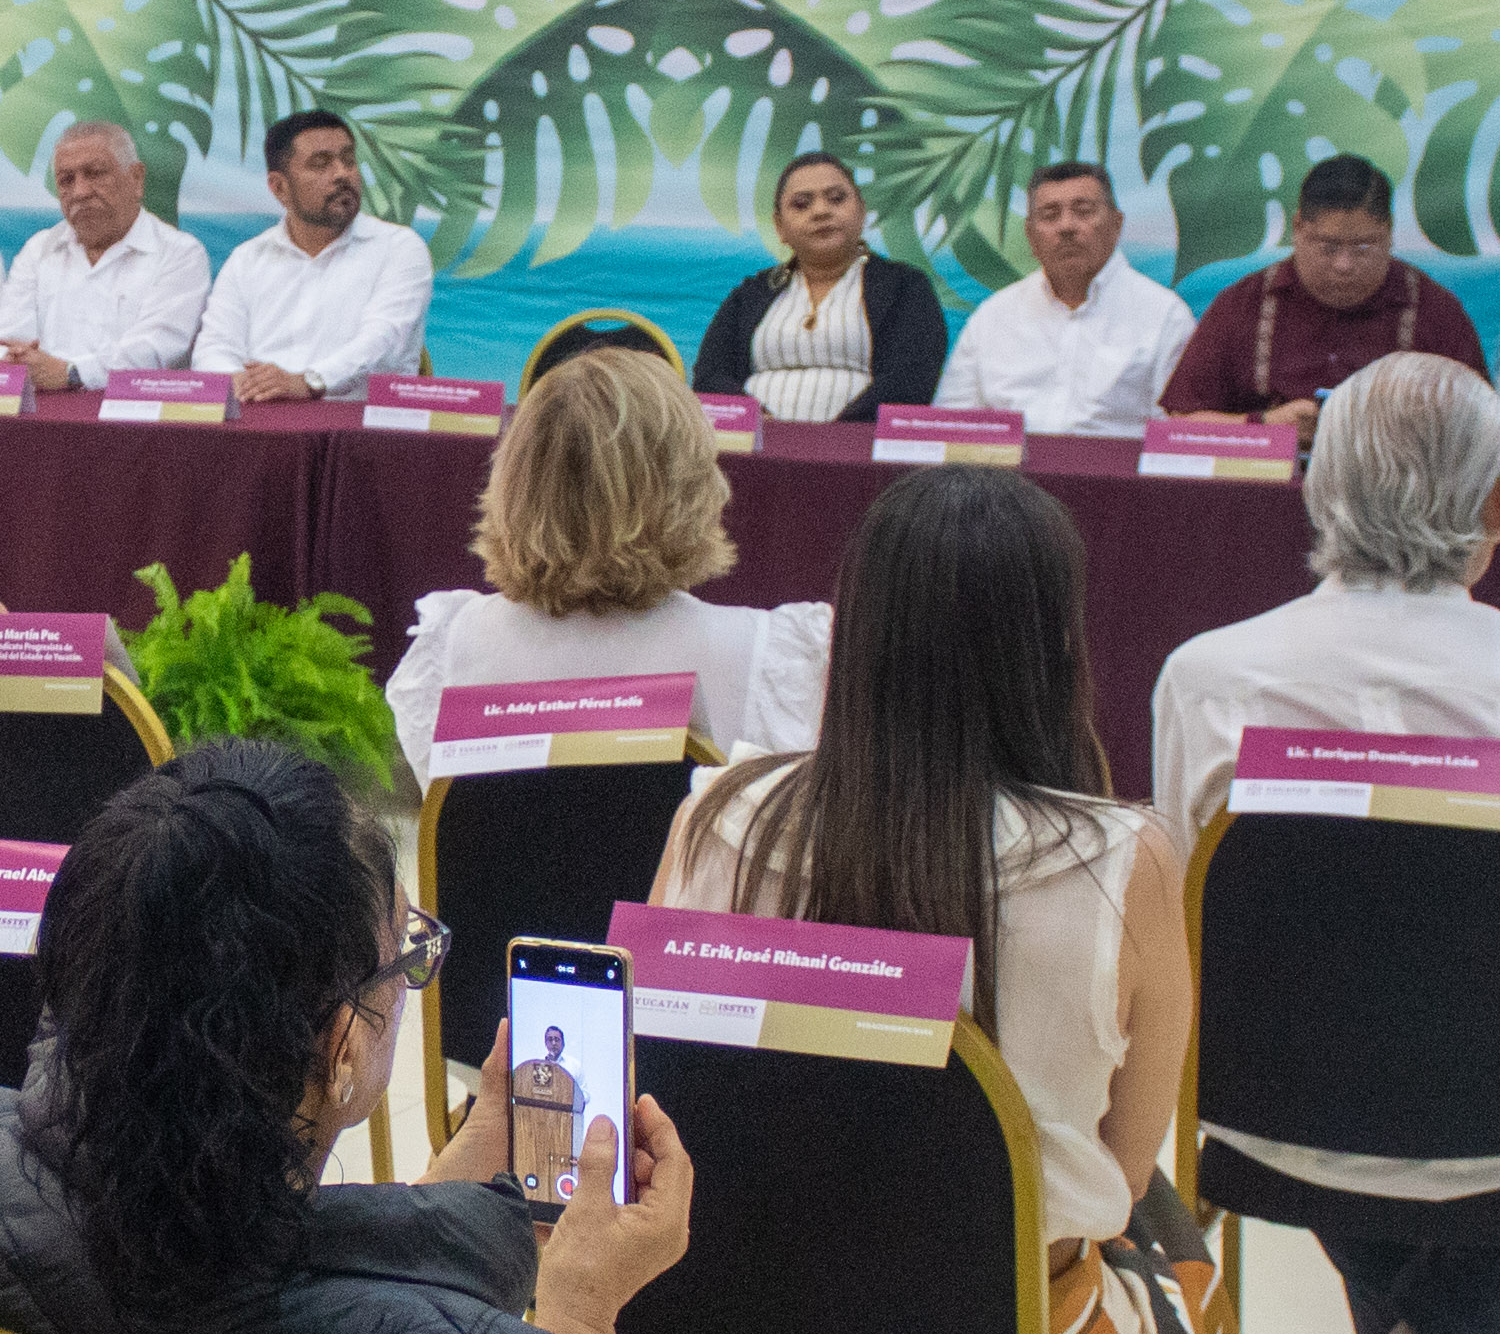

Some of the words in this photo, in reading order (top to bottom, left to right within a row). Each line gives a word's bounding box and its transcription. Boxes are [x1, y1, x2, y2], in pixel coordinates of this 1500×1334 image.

[506, 702, 538, 715] Addy
[538, 699, 577, 712] Esther
[663, 939, 696, 957] A.F.
[699, 942, 734, 960] Erik
[734, 946, 771, 964] José
[772, 949, 827, 970] Rihani
[828, 955, 904, 979] González
[717, 1002, 758, 1016] ISSTEY
